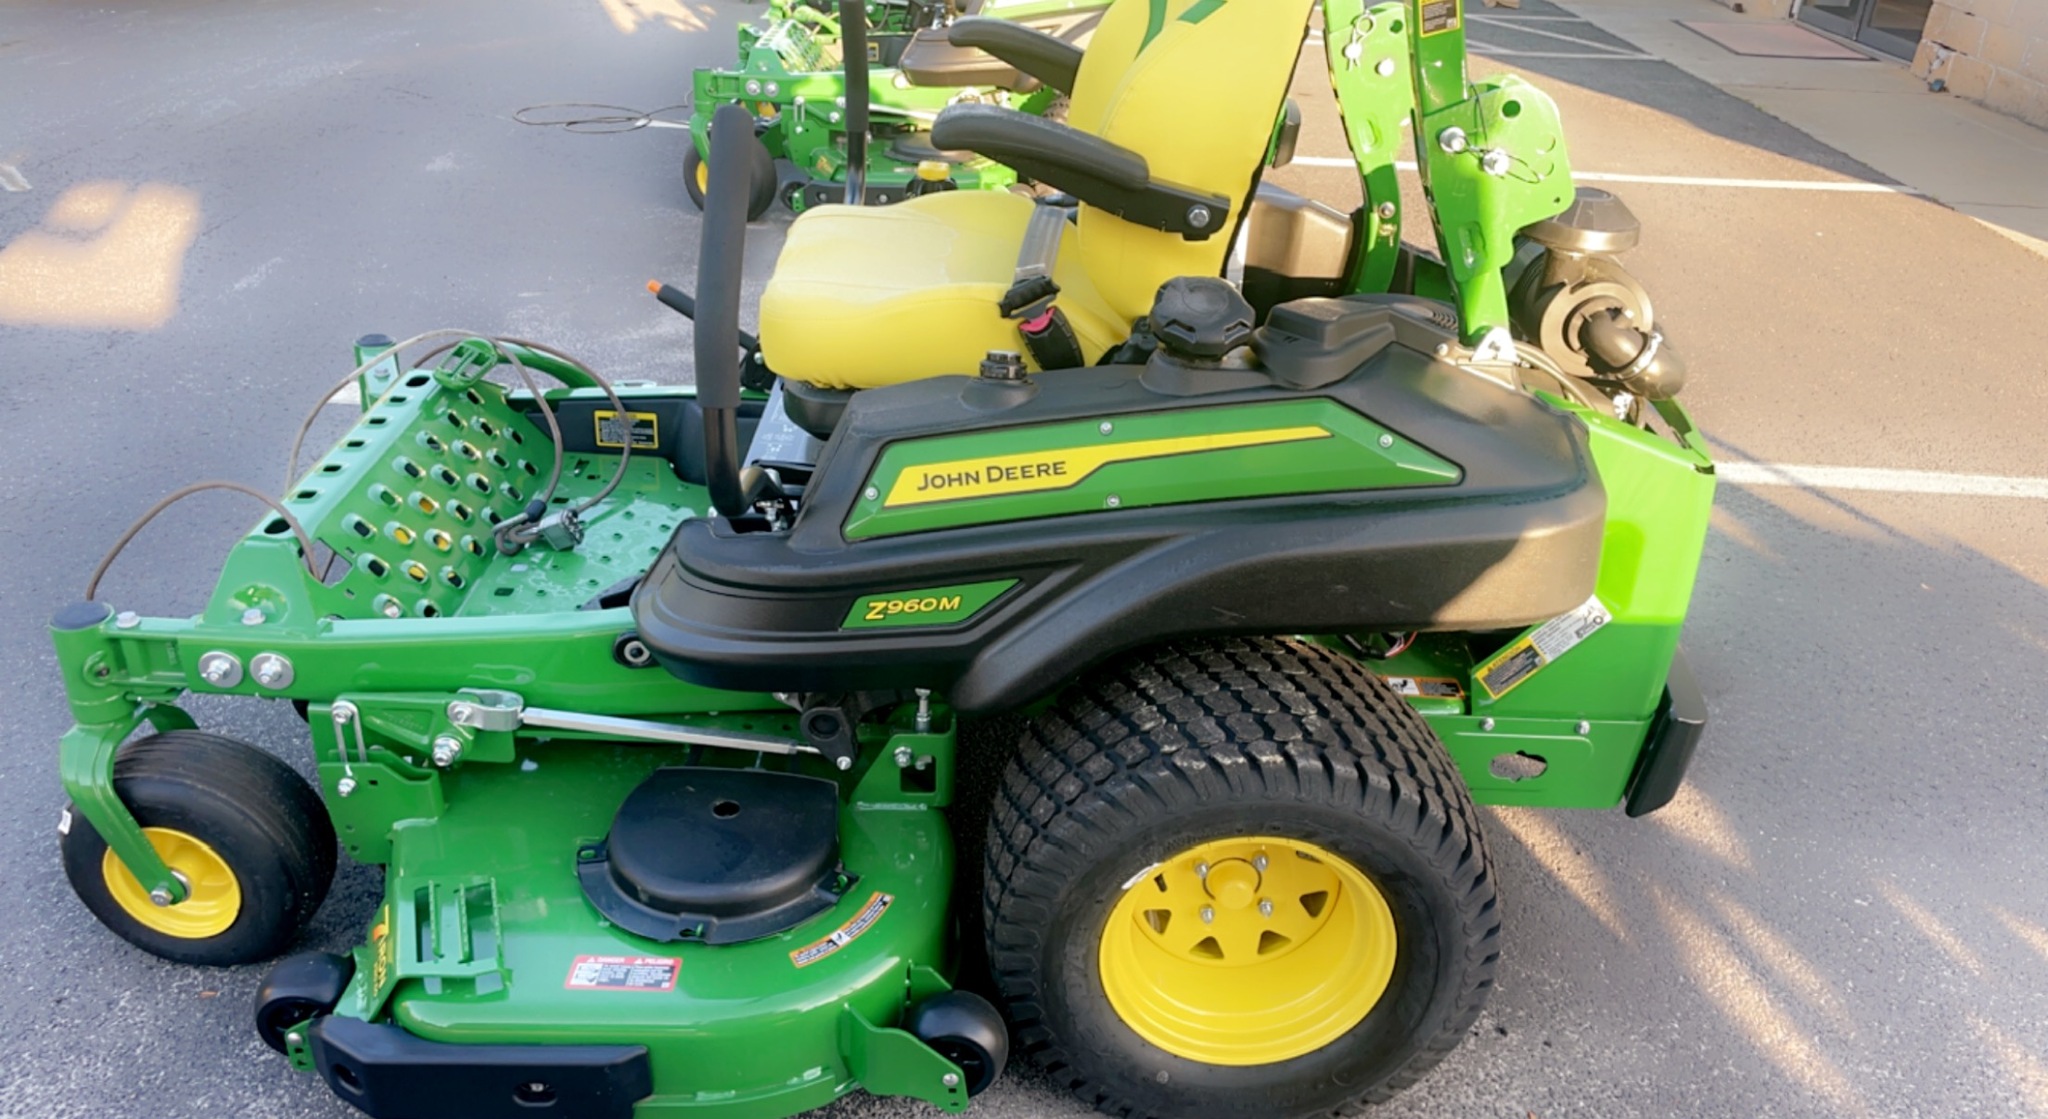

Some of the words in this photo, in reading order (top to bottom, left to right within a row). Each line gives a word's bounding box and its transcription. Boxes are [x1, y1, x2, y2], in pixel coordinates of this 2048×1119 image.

[917, 470, 980, 491] JOHN
[986, 461, 1067, 483] DEERE
[865, 596, 960, 621] Z960M
